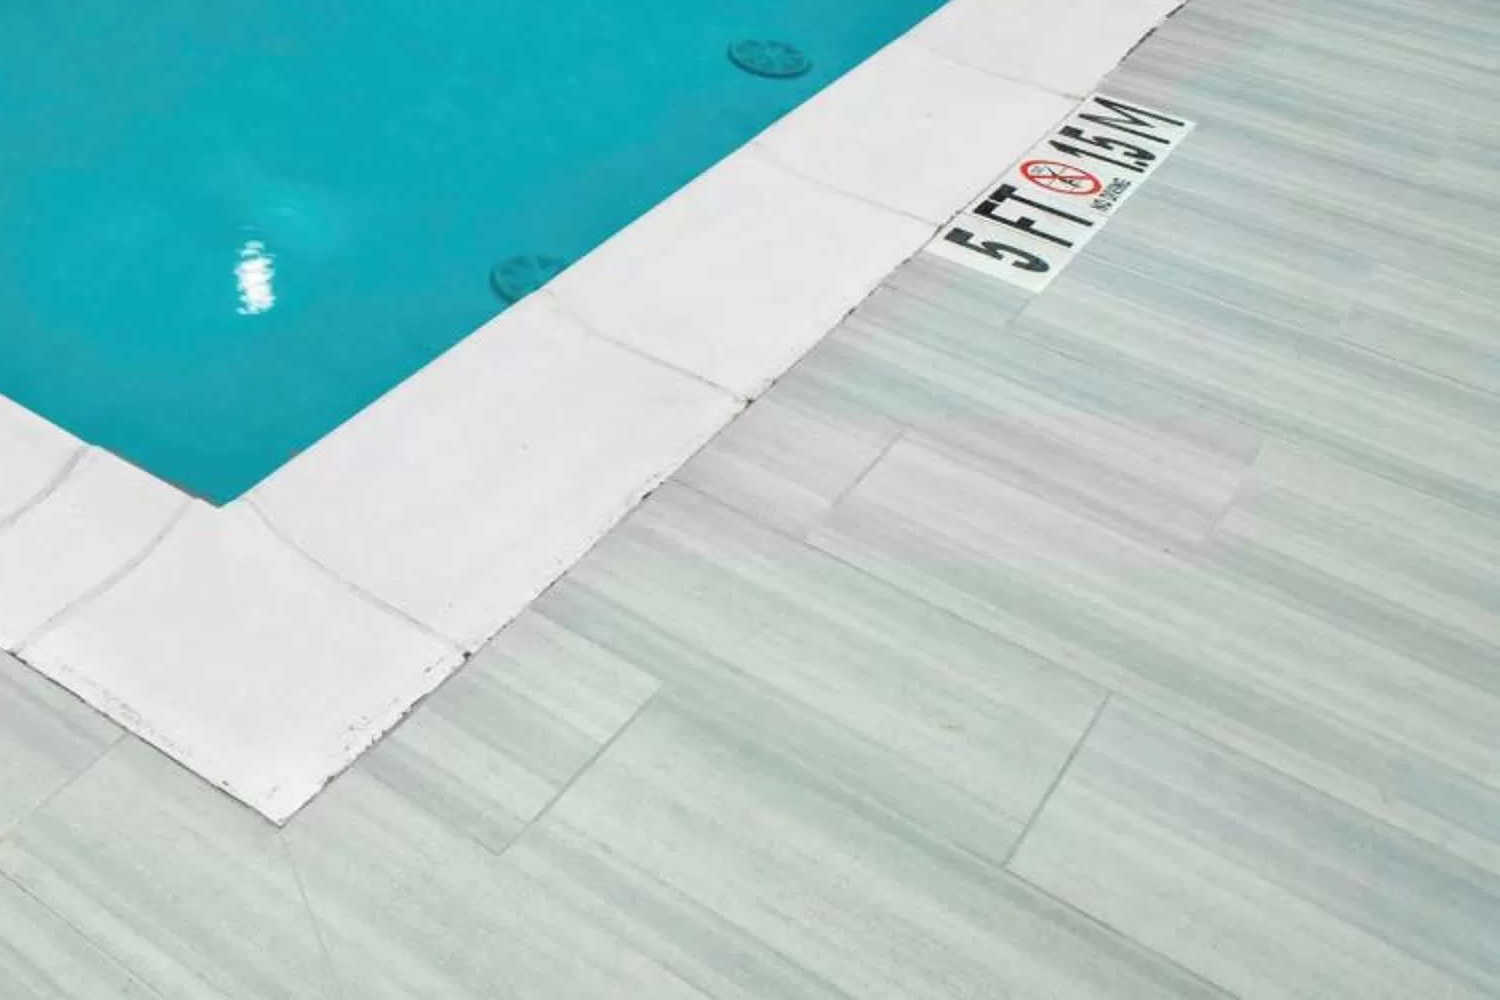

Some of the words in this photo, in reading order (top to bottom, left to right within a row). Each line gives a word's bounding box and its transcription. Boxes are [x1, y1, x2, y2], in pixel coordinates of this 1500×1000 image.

[1077, 96, 1186, 145] M
[972, 184, 1094, 248] FT
[944, 227, 1050, 273] 5
